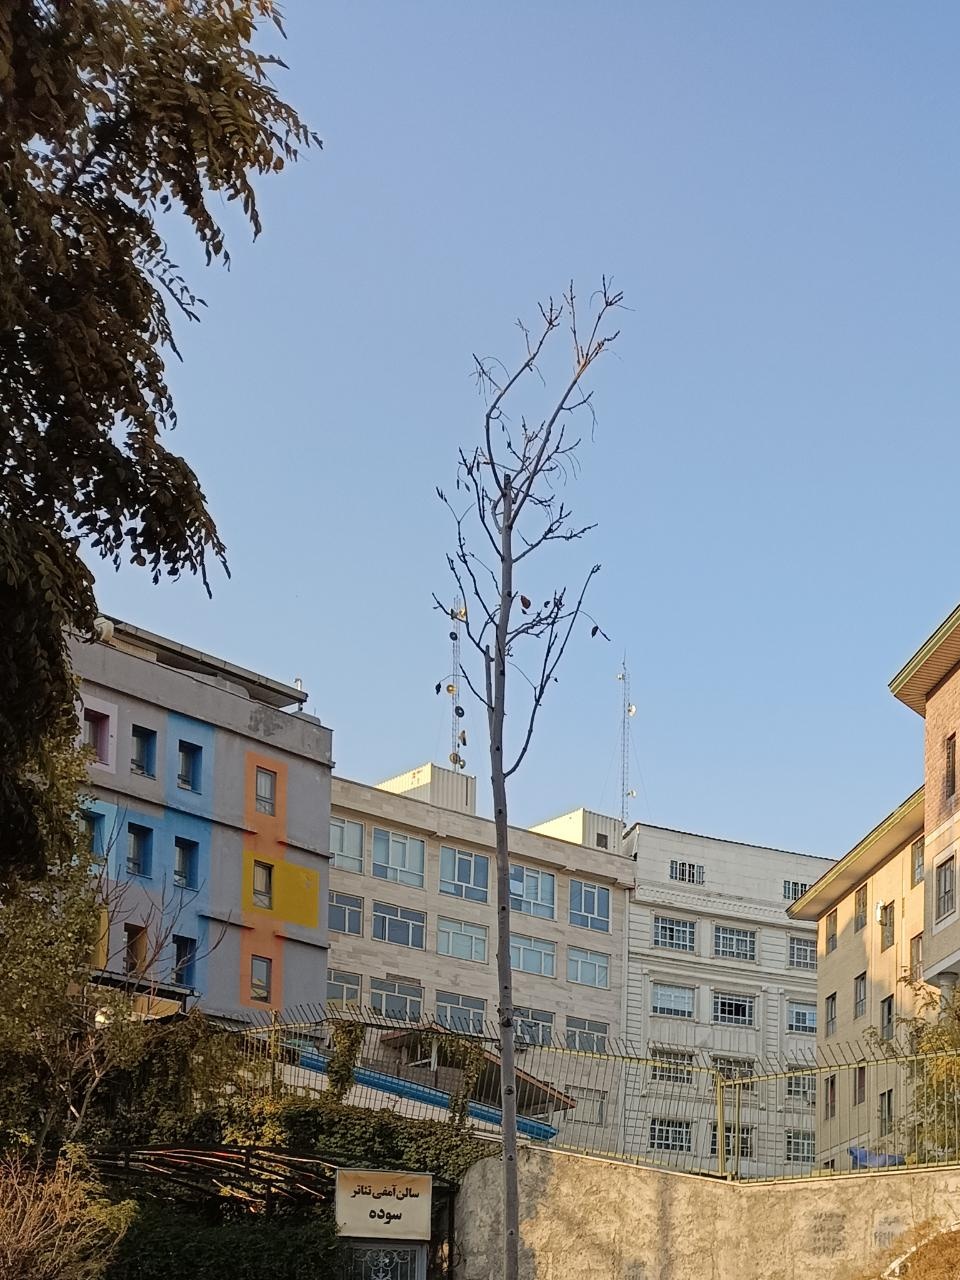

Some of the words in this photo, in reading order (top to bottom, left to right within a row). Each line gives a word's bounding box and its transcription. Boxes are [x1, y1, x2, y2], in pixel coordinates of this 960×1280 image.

[372, 1184, 397, 1199] آمفی
[395, 1187, 420, 1201] سالن
[368, 1208, 403, 1225] سوده
